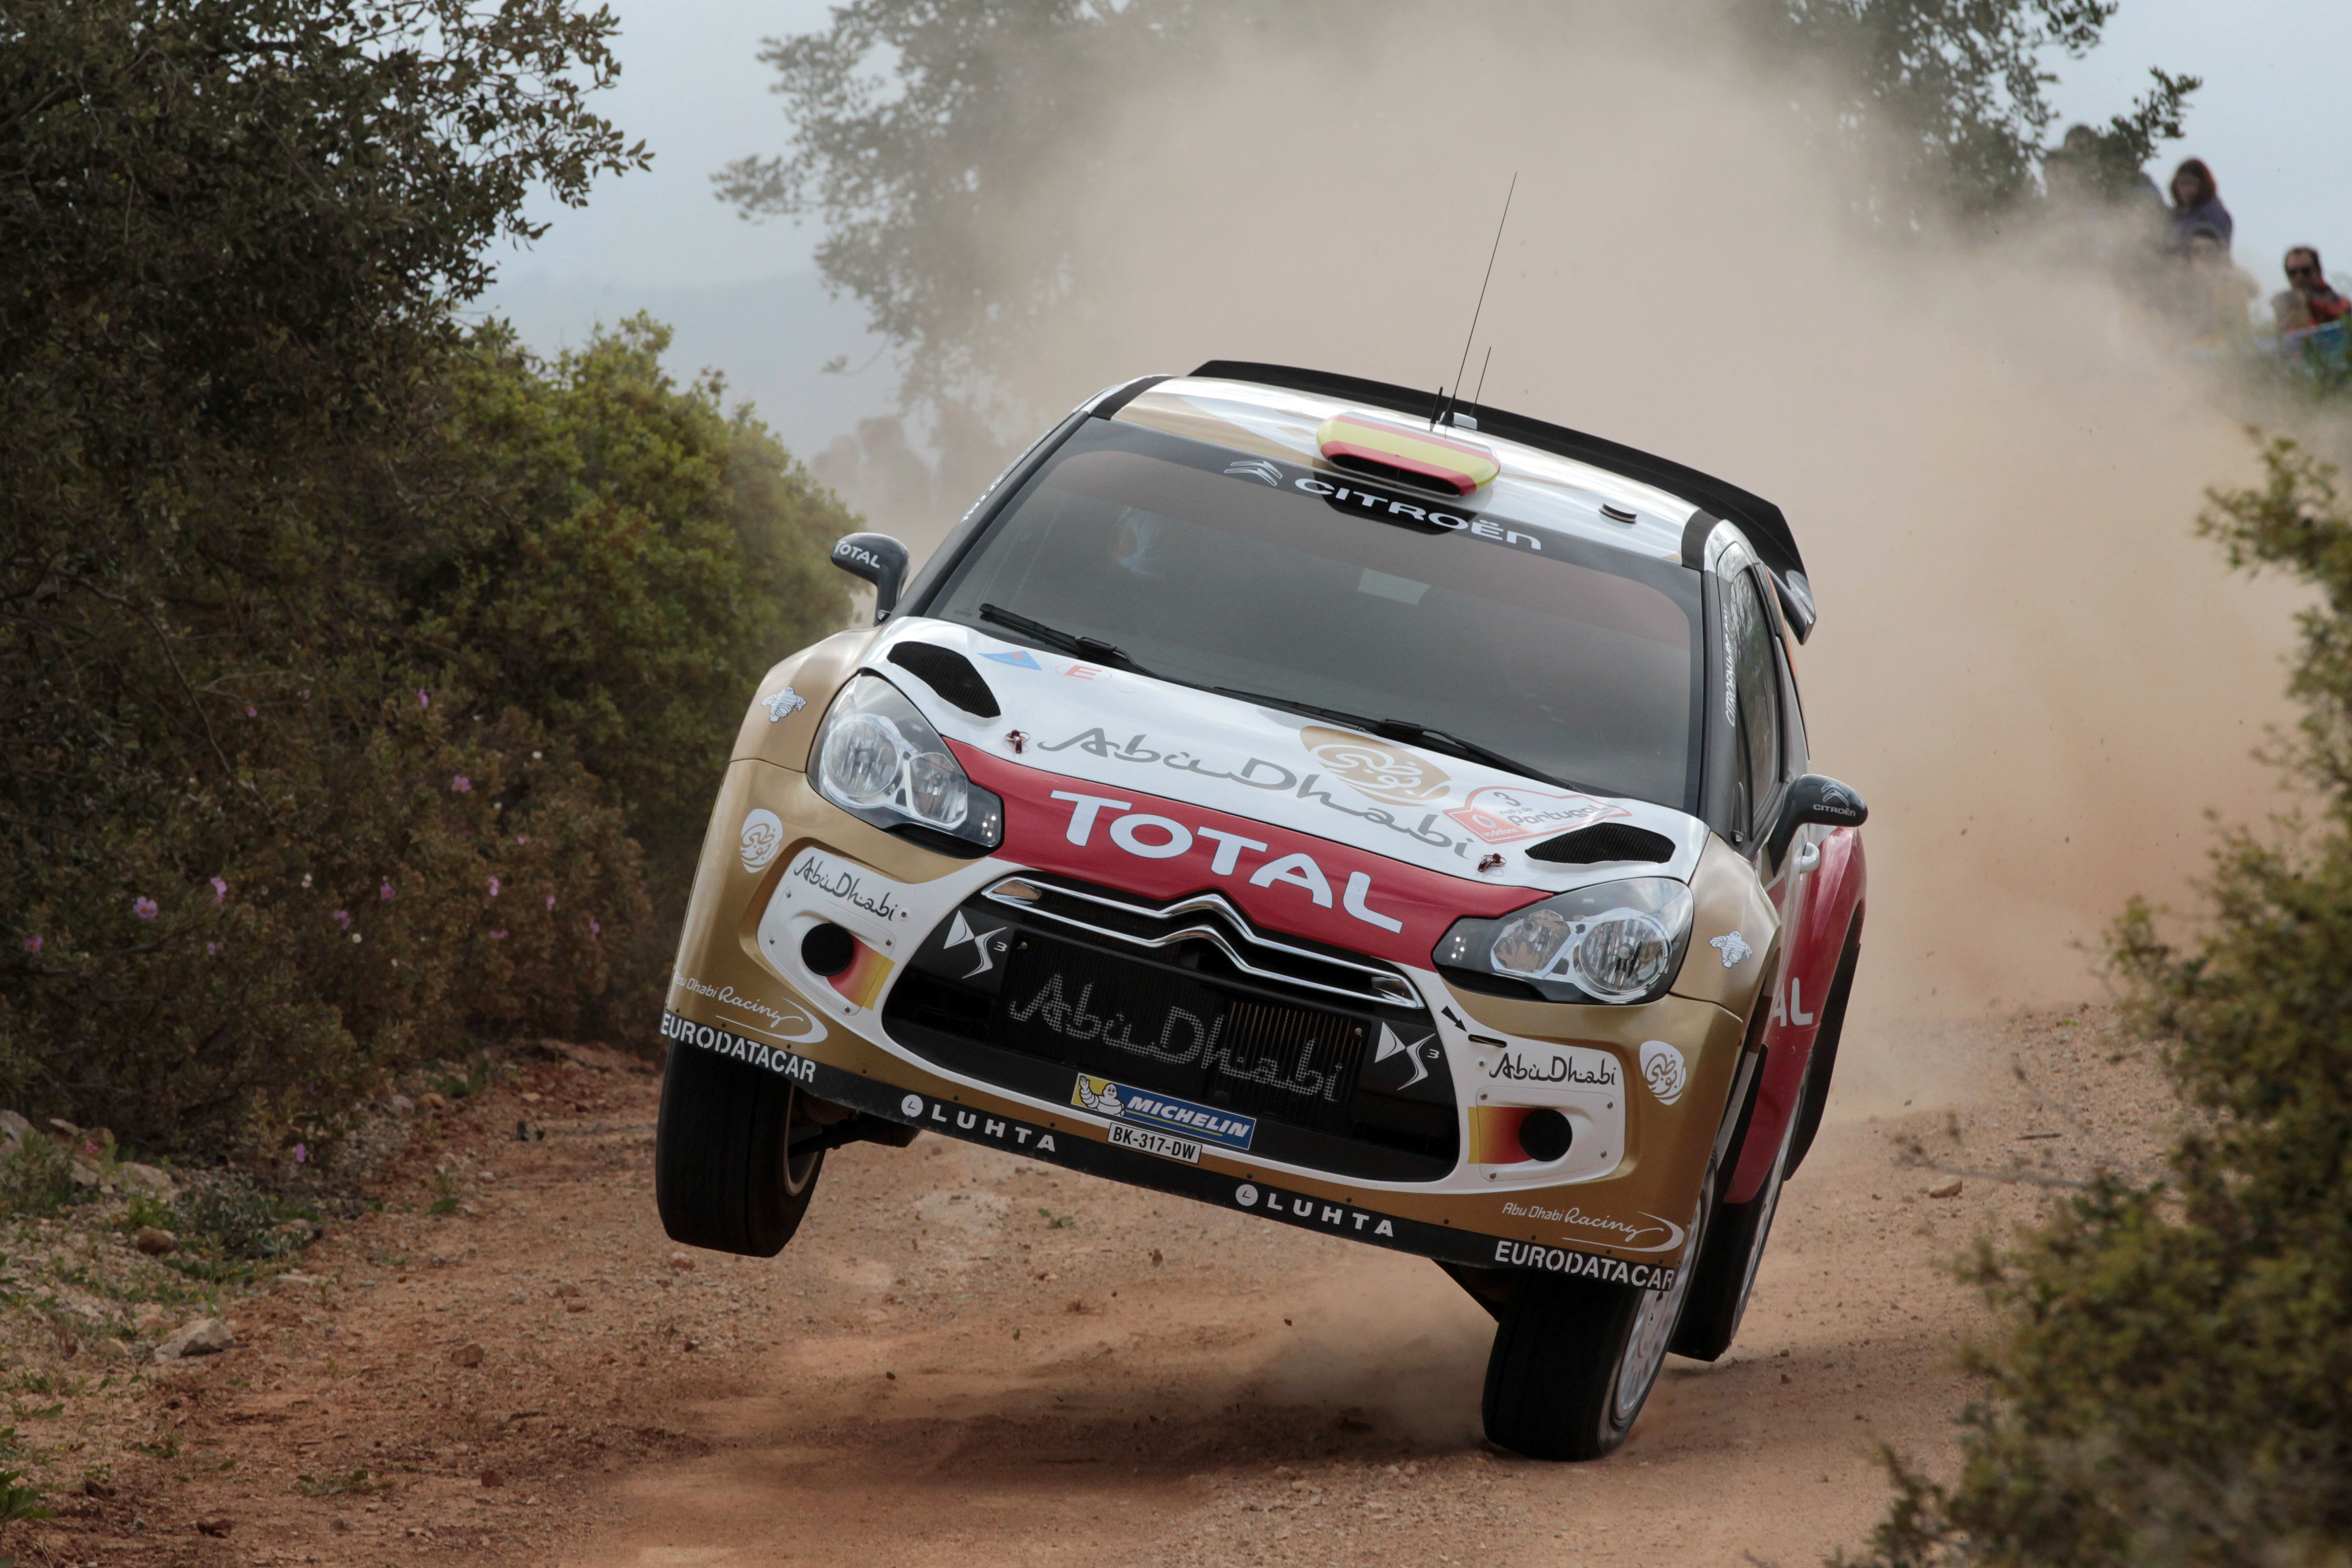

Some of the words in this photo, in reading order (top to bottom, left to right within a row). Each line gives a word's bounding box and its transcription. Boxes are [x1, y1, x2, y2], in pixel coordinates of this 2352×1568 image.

[835, 541, 881, 569] TOTAL
[1064, 665, 1102, 681] E
[1493, 791, 1521, 807] 3
[1507, 804, 1608, 827] Portugal
[1481, 827, 1519, 838] vodafone
[1050, 790, 1404, 934] TOTAL
[673, 971, 687, 986] Abu
[686, 977, 720, 999] Dhabi
[718, 986, 804, 1029] Racing
[661, 1012, 817, 1084] EURODATACAR
[931, 1103, 1056, 1153] LUHTA
[1127, 1095, 1251, 1137] MICHELIN
[1112, 1126, 1196, 1160] BK-317-DW
[1267, 1192, 1393, 1237] LUHTA
[1502, 1202, 1528, 1216] Abu
[1528, 1205, 1565, 1222] Dhabi
[1564, 1207, 1665, 1242] Racing
[1495, 1240, 1675, 1290] EURODATACAR
